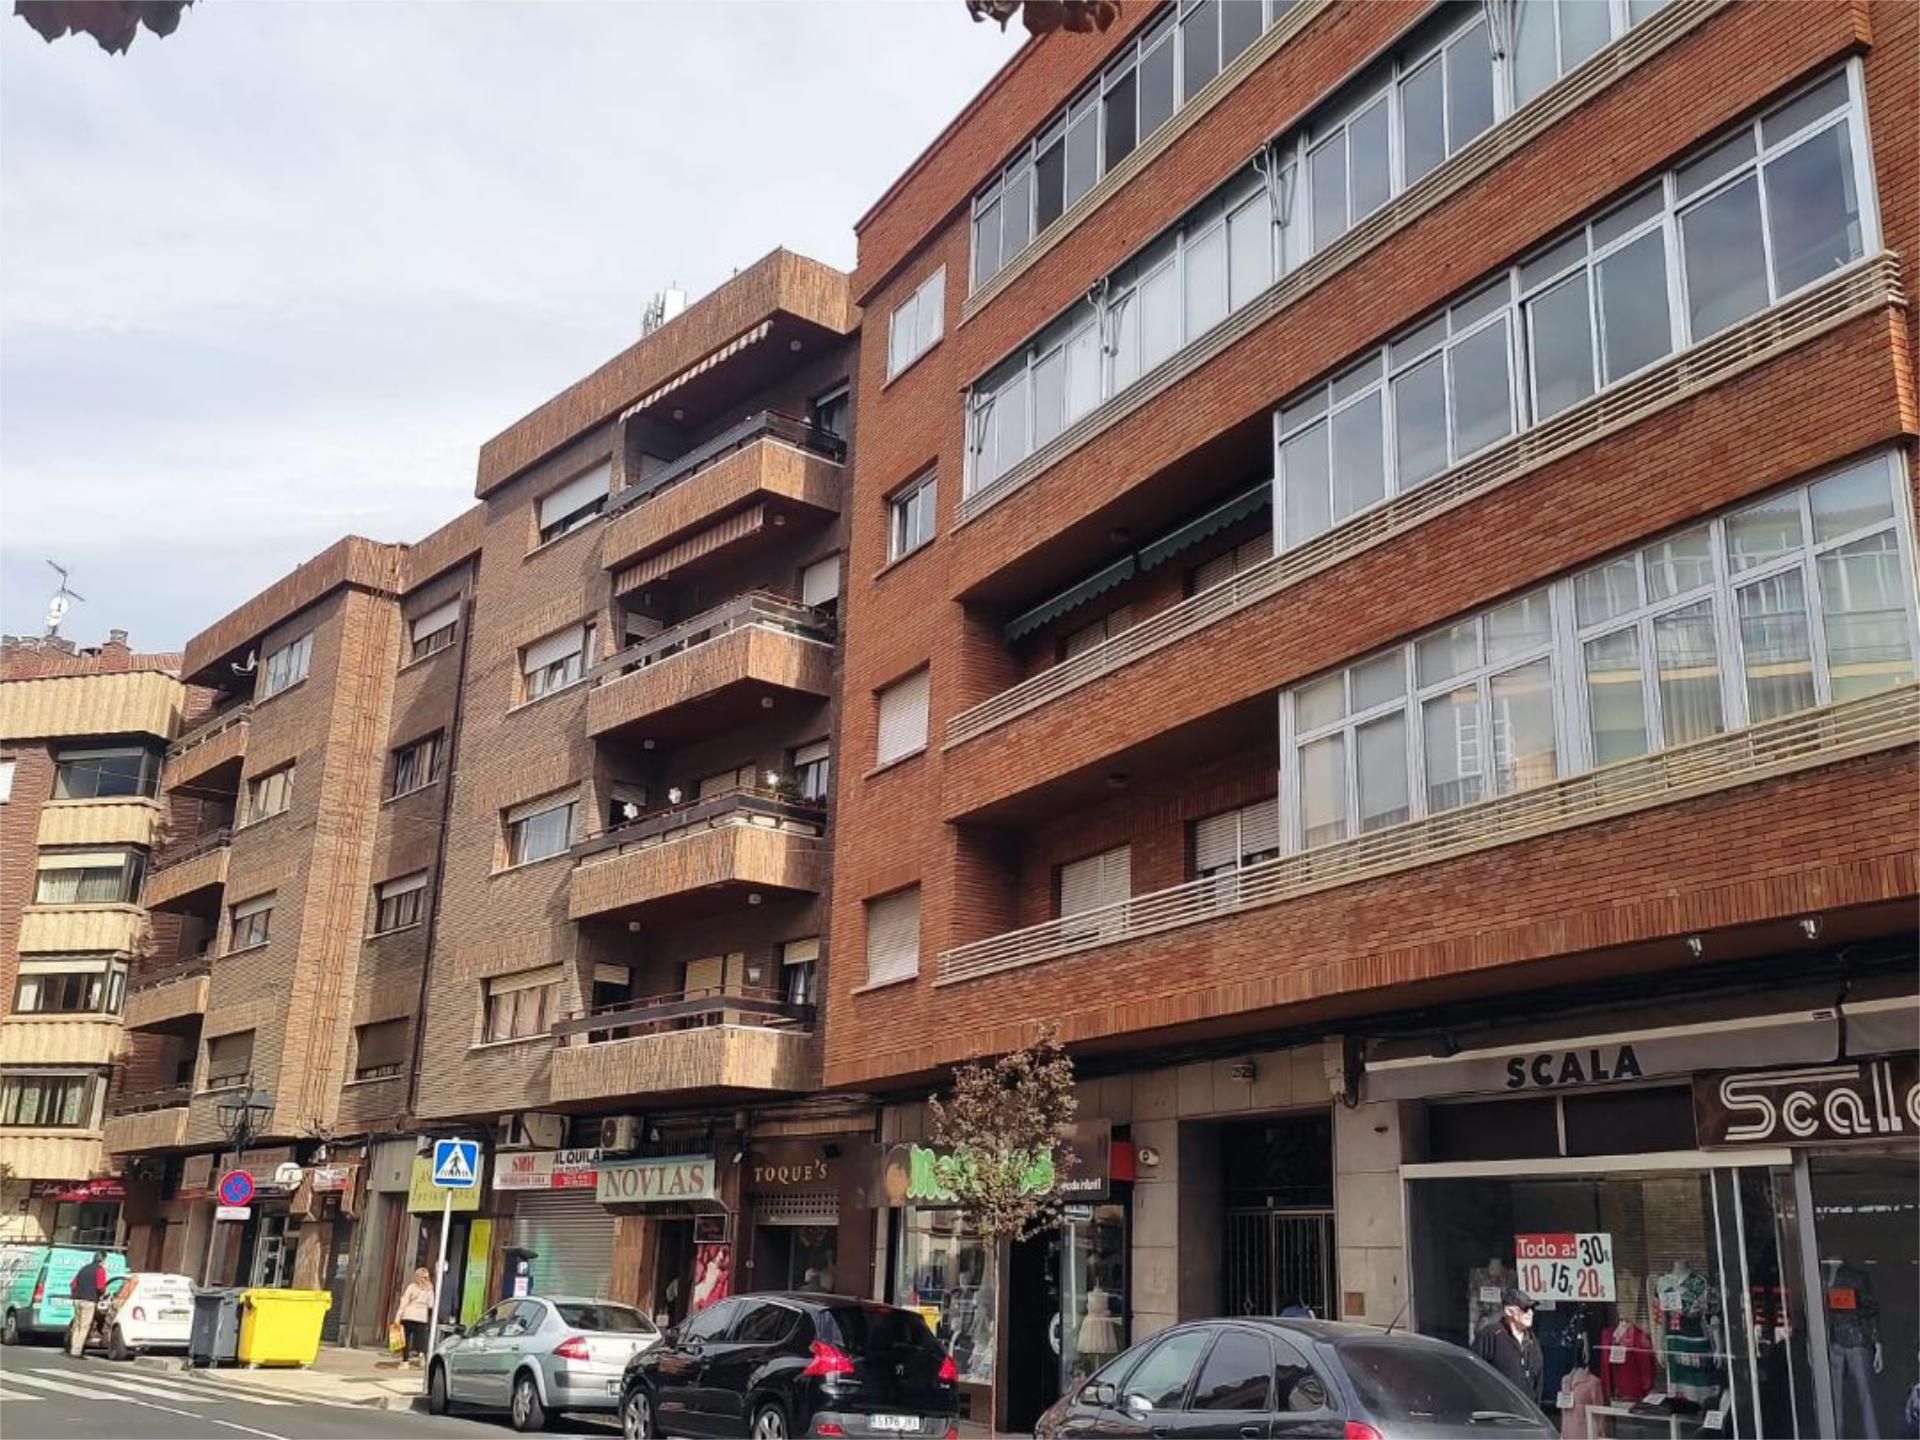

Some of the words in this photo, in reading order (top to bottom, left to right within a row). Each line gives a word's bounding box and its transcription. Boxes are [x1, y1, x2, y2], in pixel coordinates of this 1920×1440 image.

[1507, 1045, 1642, 1088] SCALA
[553, 1149, 600, 1165] ALQUILA
[605, 1165, 705, 1197] NOVIAS
[754, 1158, 827, 1184] TOQUE'S
[1518, 1238, 1556, 1257] Todo
[1562, 1243, 1576, 1257] a:
